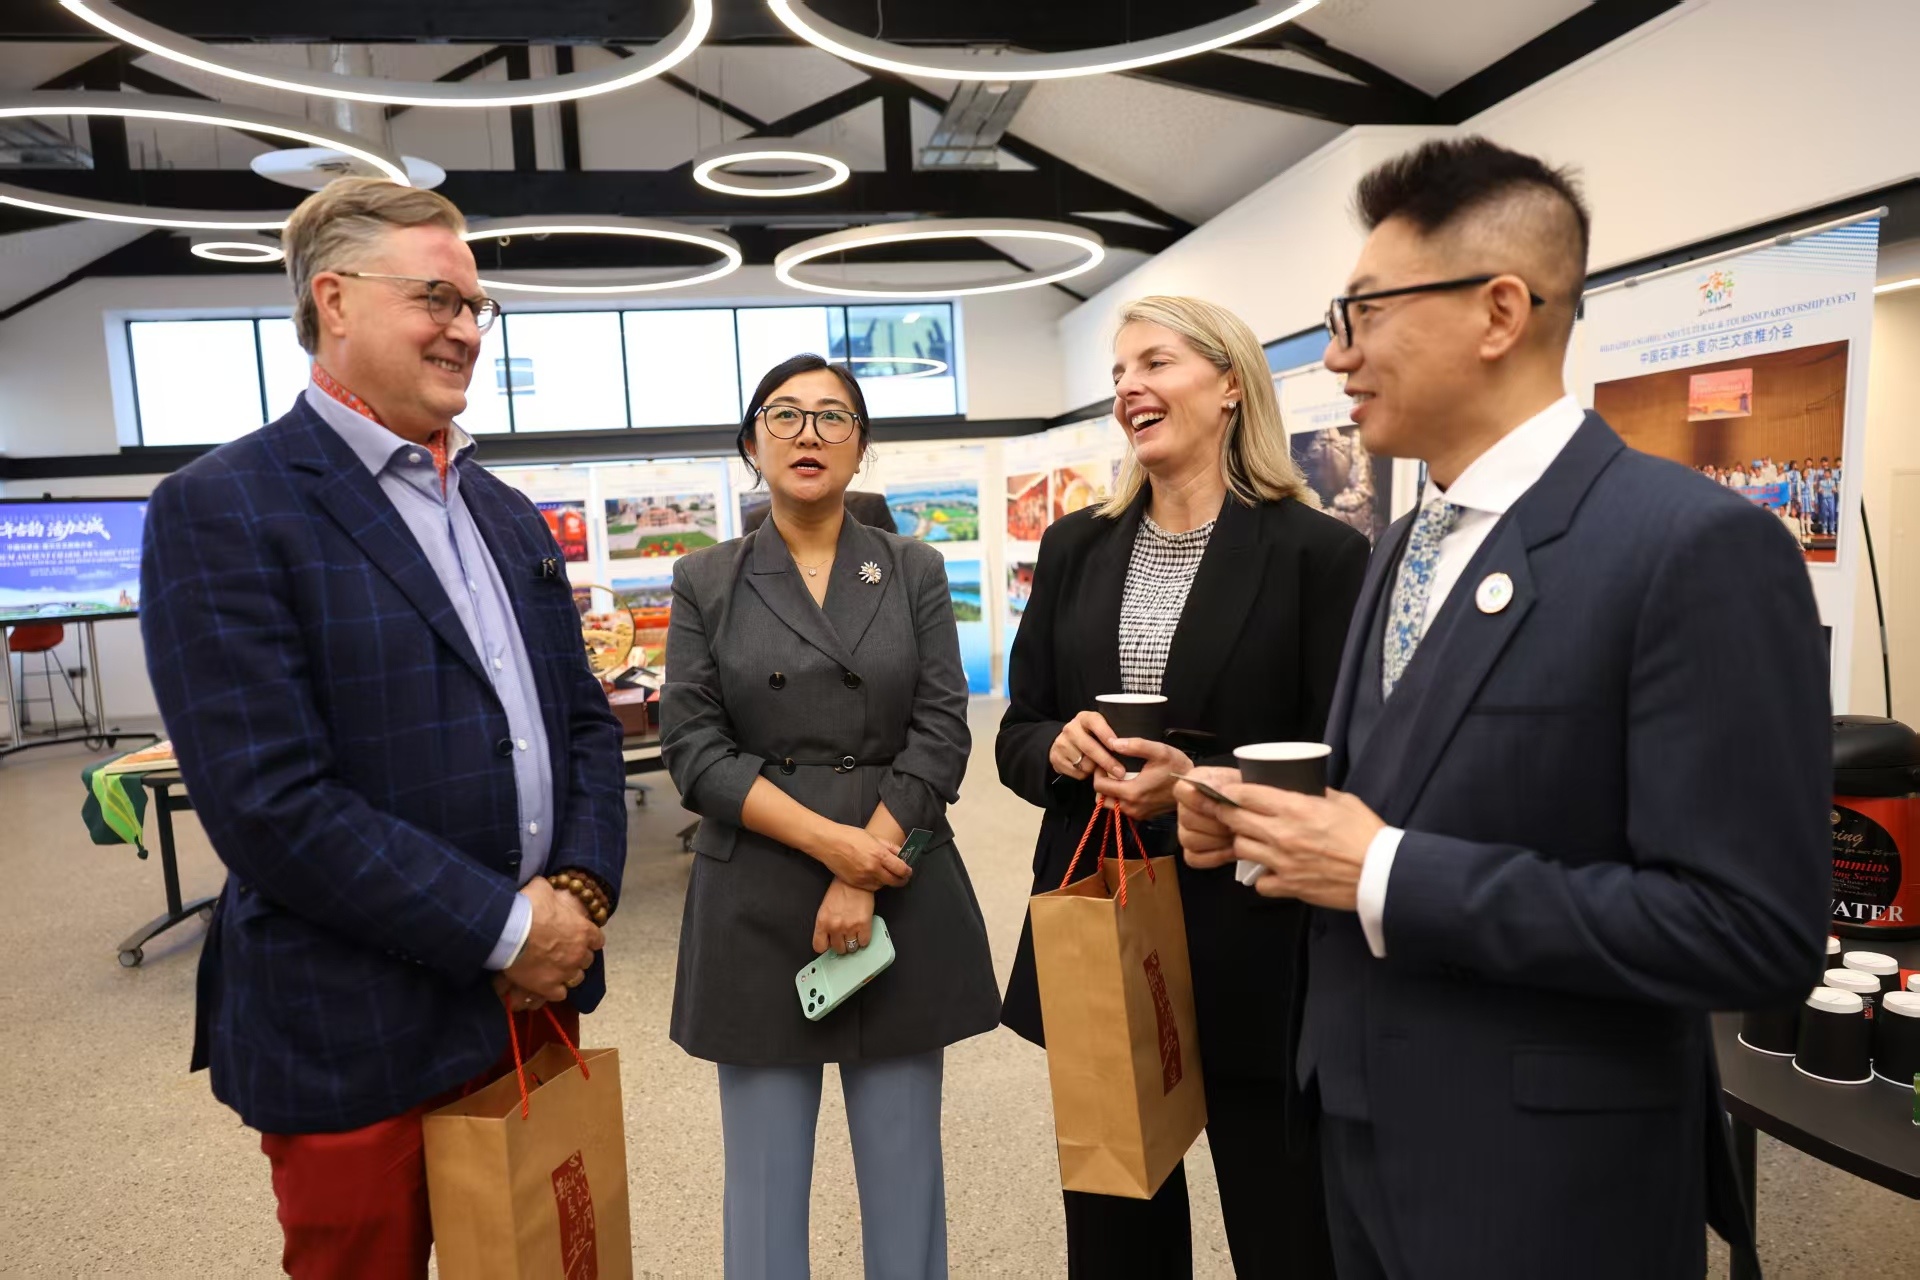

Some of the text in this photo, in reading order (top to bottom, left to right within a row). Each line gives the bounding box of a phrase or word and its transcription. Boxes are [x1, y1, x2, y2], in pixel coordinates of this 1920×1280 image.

[1763, 299, 1825, 319] PARTNERSHIP
[1826, 291, 1856, 306] EVENT
[1832, 859, 1889, 873] mmins
[1830, 899, 1904, 922] ATER
